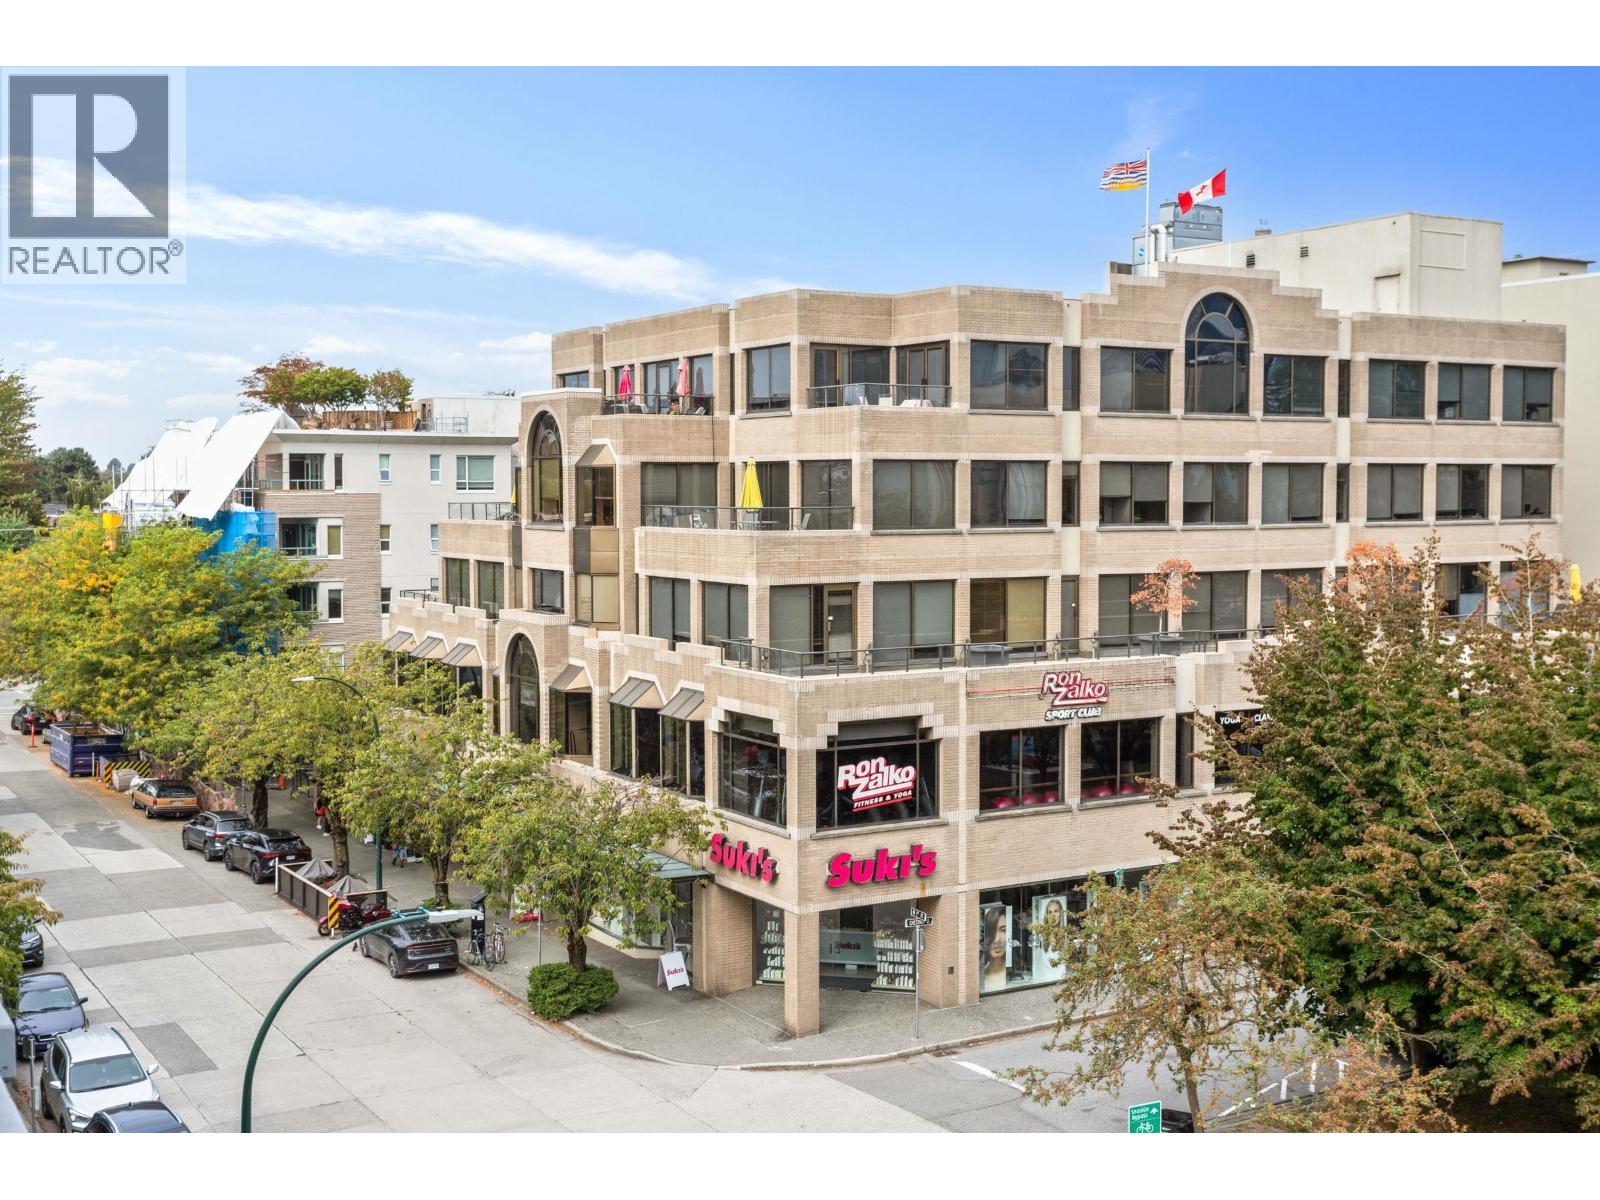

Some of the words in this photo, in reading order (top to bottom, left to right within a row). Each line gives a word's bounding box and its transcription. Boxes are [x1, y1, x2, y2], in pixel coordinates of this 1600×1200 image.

[1043, 670, 1082, 693] Ron
[1052, 679, 1108, 706] Zalko
[1045, 709, 1076, 720] SPORT
[1220, 715, 1241, 724] YOGA
[837, 756, 886, 789] Ron
[852, 764, 916, 801] Zalko
[853, 797, 883, 809] FITNESS
[893, 790, 912, 799] YOGA
[709, 832, 777, 884] Suki's
[826, 843, 937, 889] Suki's
